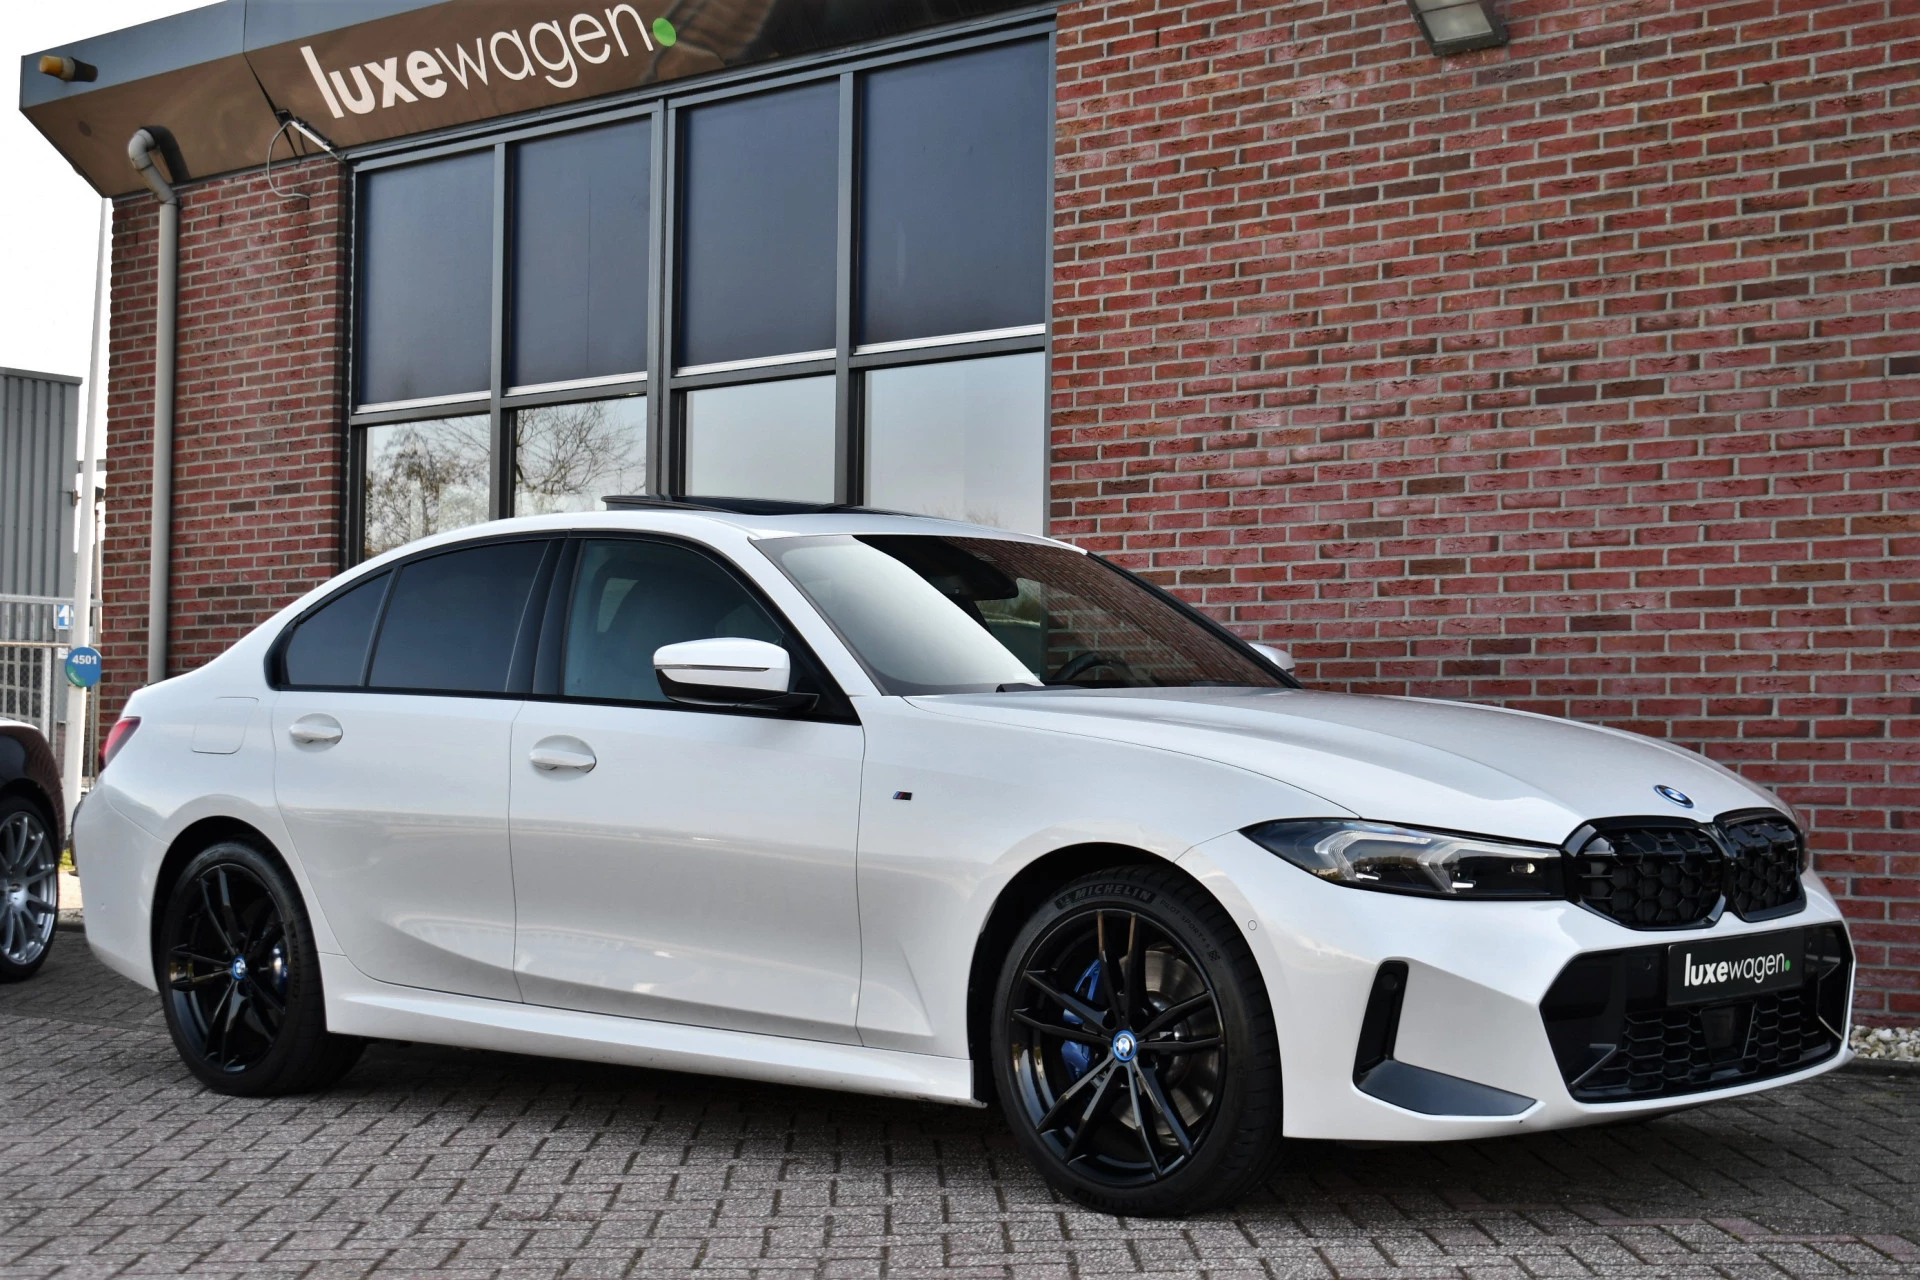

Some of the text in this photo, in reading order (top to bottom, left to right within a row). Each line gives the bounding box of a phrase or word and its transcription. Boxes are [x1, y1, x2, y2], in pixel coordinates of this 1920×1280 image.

[72, 654, 97, 665] 4501
[1075, 884, 1153, 902] MICHELIN
[1160, 899, 1181, 915] PILOT
[1181, 915, 1204, 938] SPORT
